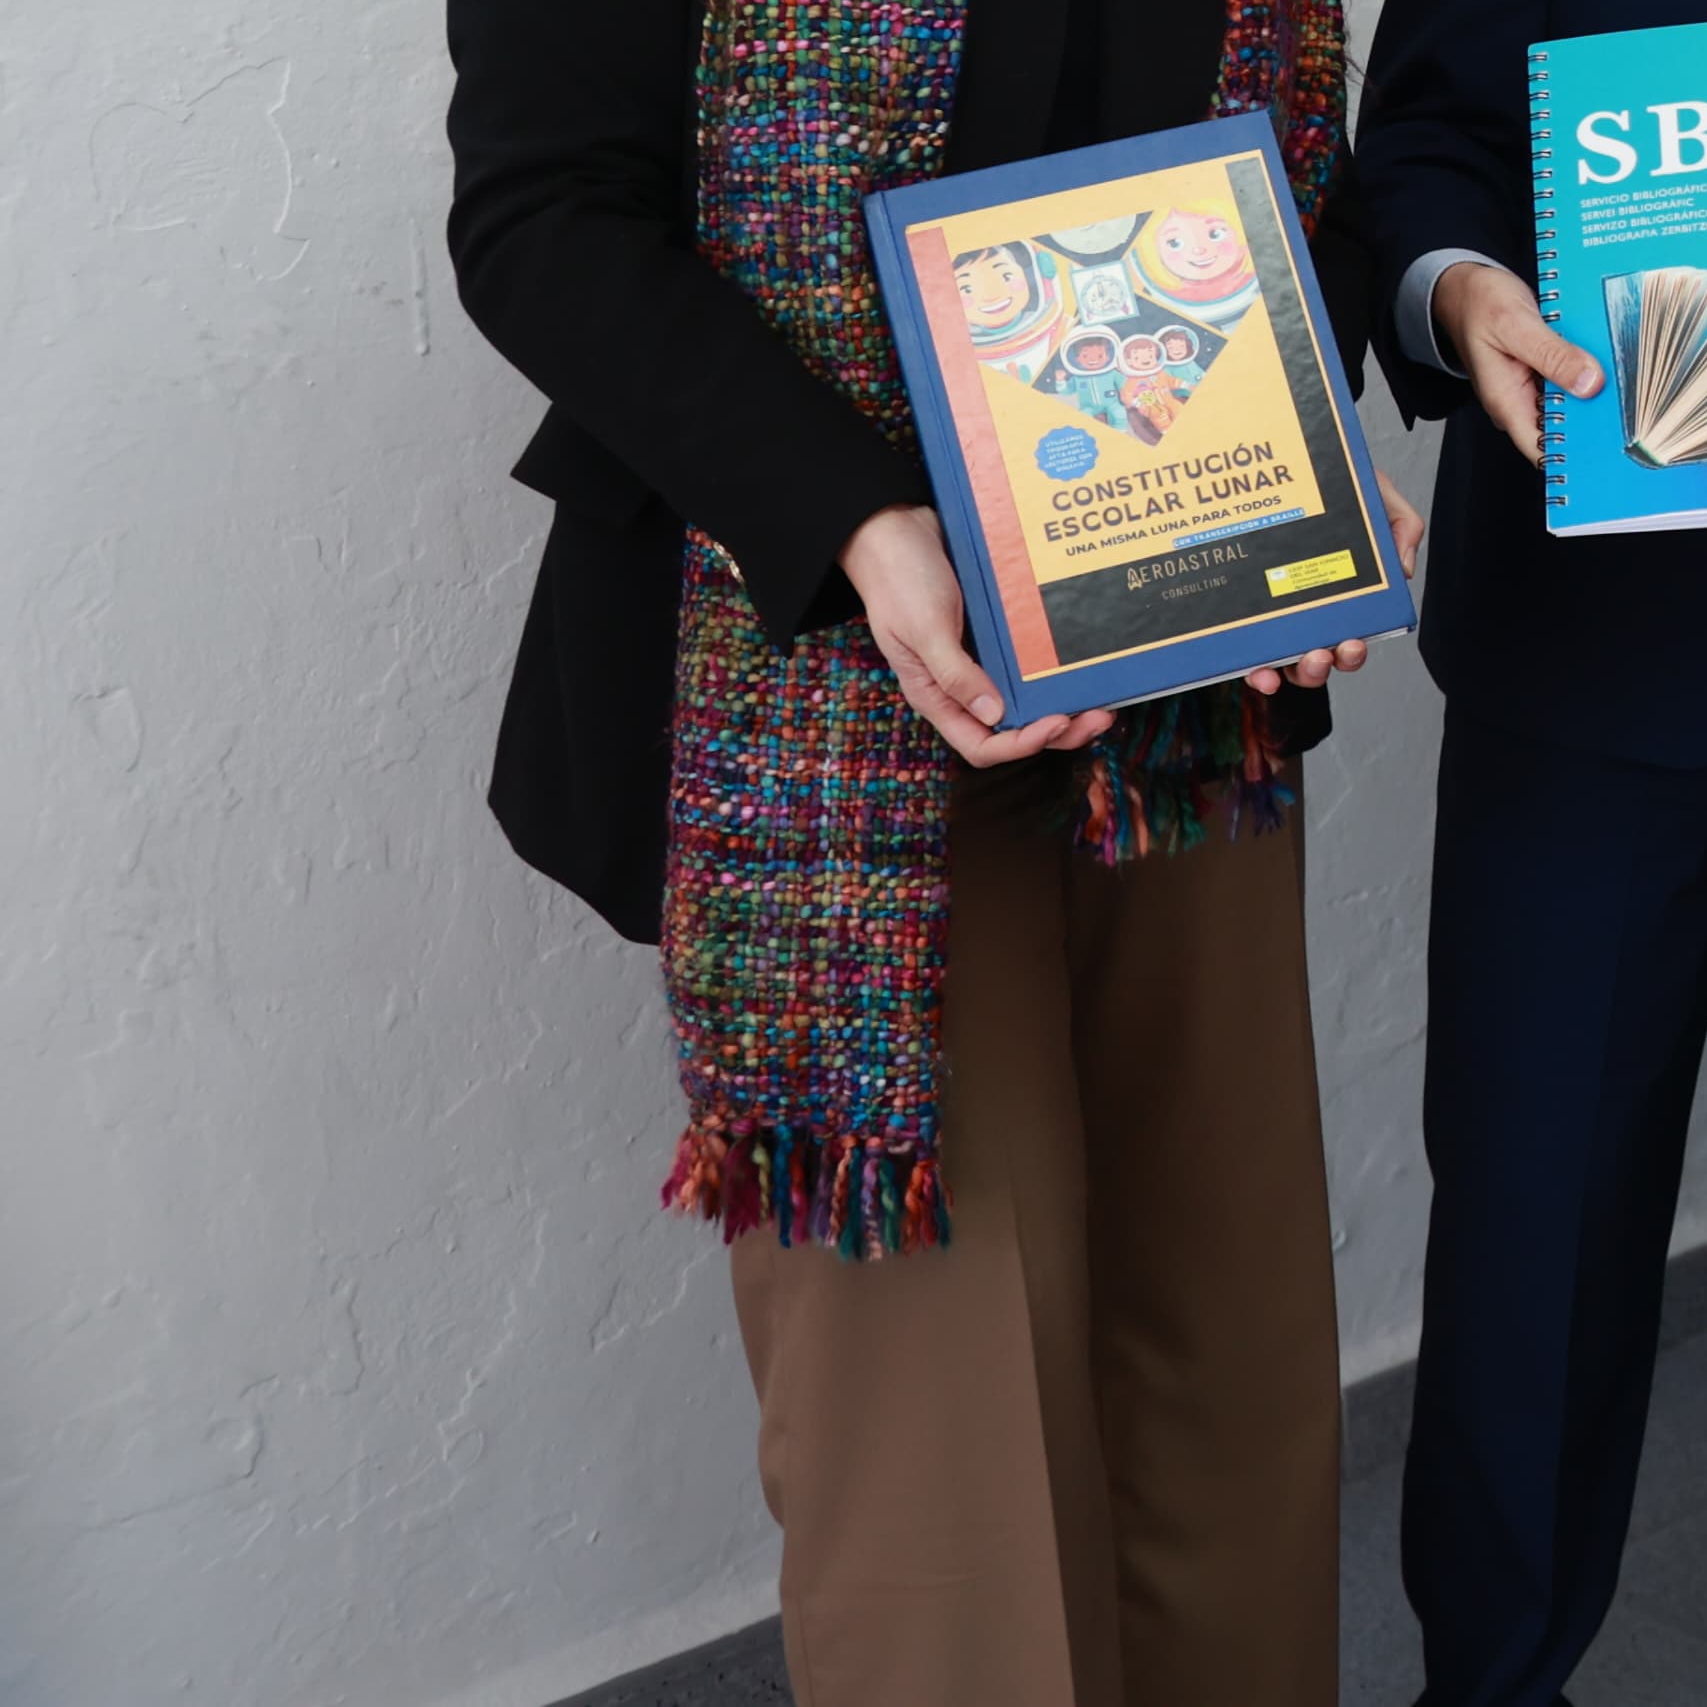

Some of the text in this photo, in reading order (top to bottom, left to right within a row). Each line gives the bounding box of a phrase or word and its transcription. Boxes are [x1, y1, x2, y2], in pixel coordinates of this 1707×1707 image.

[1580, 193, 1629, 209] SERVICIO
[1581, 208, 1616, 222] SERVEI
[1582, 220, 1627, 235] SERVIZO
[1582, 228, 1657, 247] BIBLIOGRAFIA
[1052, 441, 1274, 511] CONSTITUCIÓN
[1043, 465, 1295, 542] ESCOLAR LUNAR
[1066, 495, 1282, 557] UNA MISMA LUNA PARA TODOS
[1127, 543, 1249, 591] AEROASTRAL
[1162, 576, 1228, 600] CONSULTING
